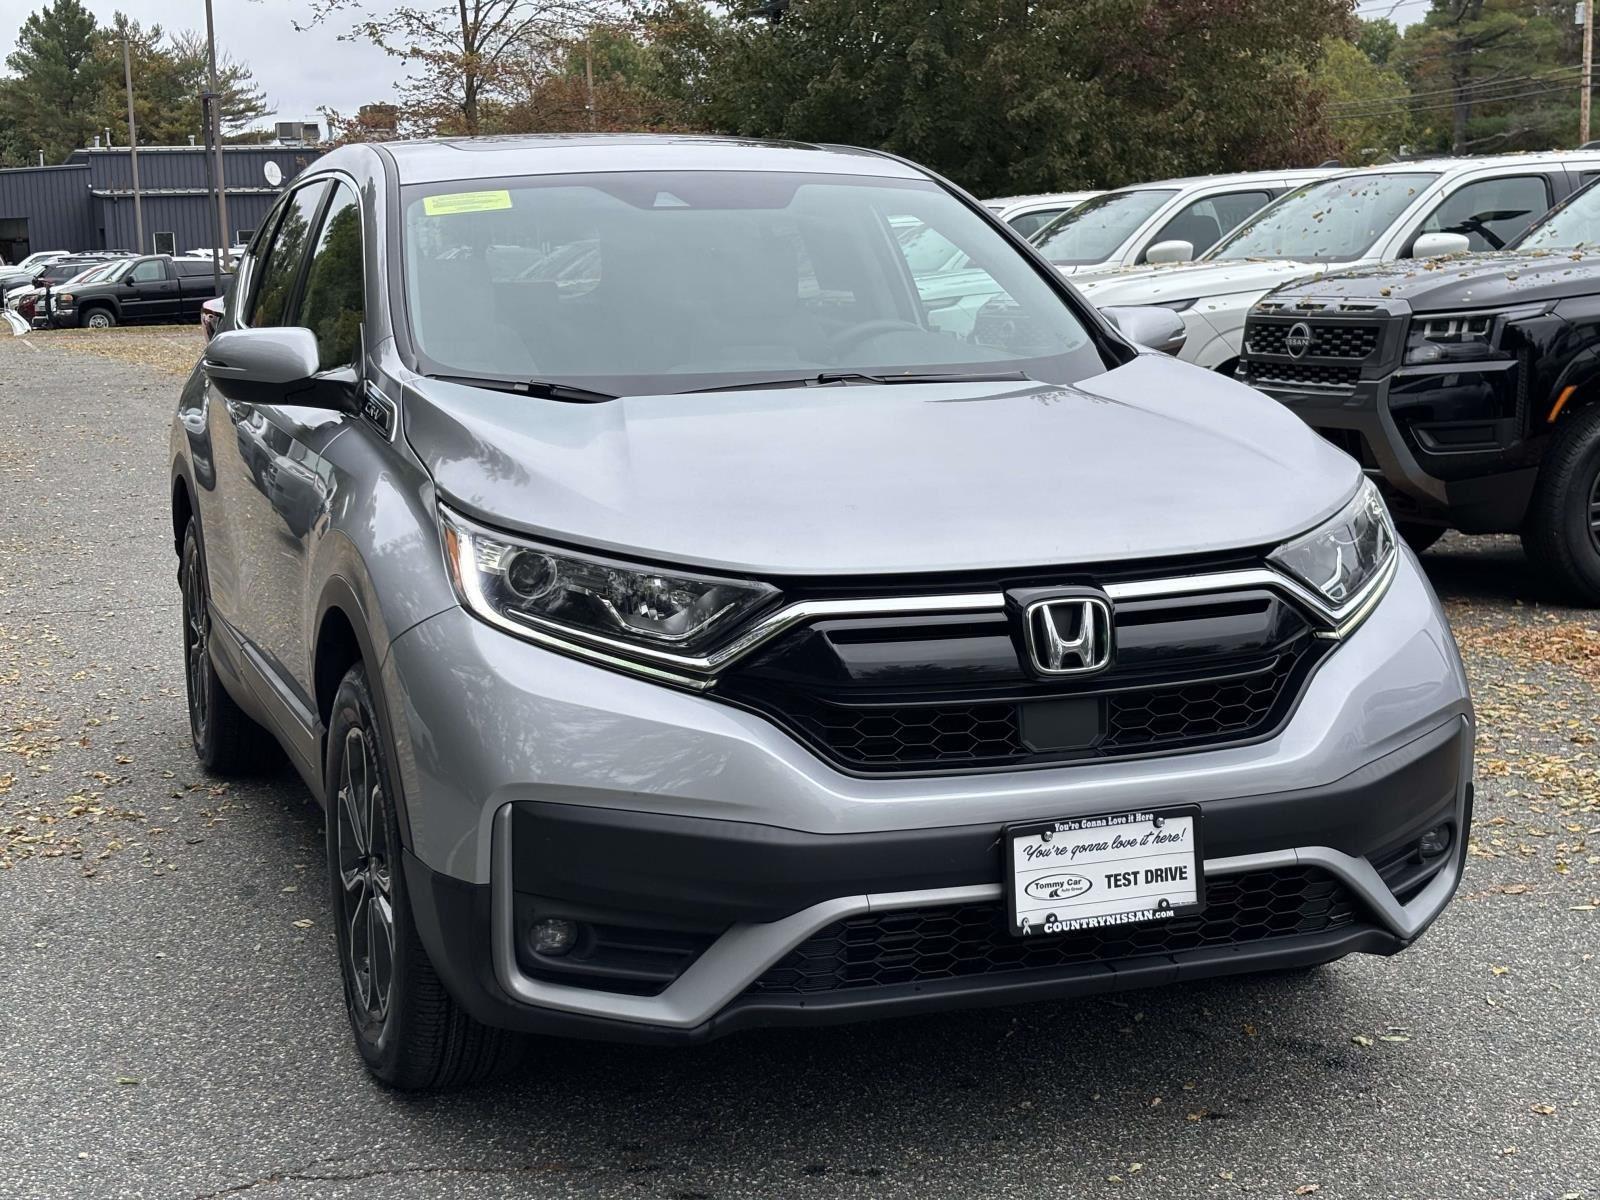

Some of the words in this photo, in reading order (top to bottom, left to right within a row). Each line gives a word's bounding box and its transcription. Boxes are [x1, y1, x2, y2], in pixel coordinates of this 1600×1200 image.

[1055, 822, 1079, 832] You're
[1081, 819, 1107, 829] Gonna
[1108, 816, 1126, 825] Love
[1128, 814, 1134, 822] it
[1136, 813, 1154, 821] Here
[1023, 844, 1068, 861] You're
[1070, 841, 1109, 860] gonna
[1111, 834, 1137, 849] love
[1139, 831, 1154, 846] it
[1152, 827, 1187, 844] here!
[1034, 881, 1065, 890] Tommy
[1066, 878, 1082, 886] Car
[1105, 871, 1140, 889] TEST
[1145, 866, 1188, 884] DRIVE
